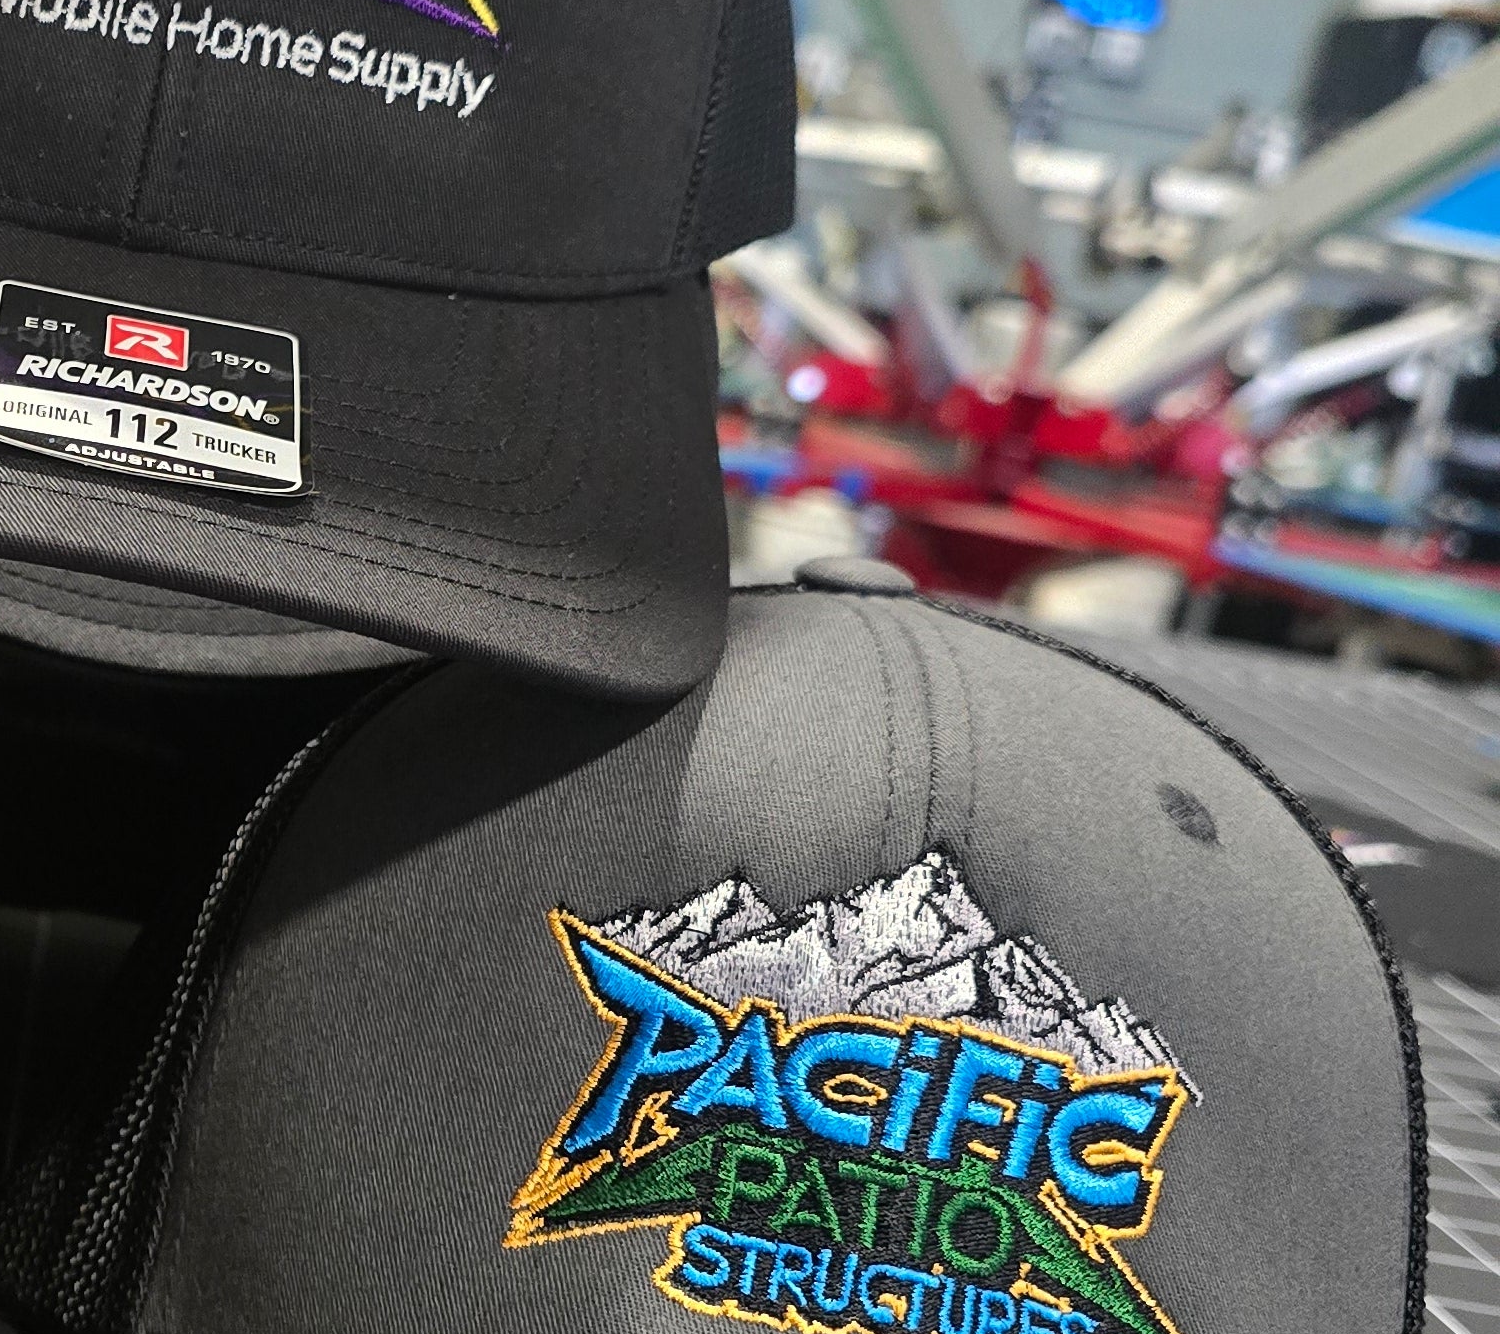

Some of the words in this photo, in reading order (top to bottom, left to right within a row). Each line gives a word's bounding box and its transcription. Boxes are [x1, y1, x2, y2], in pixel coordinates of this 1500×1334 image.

[165, 2, 325, 77] Home
[327, 30, 497, 118] Supply
[24, 316, 82, 336] EST.
[210, 349, 272, 375] 1970
[2, 398, 94, 427] ORIGINAL
[104, 407, 180, 451] 112
[190, 431, 278, 466] TRUCKER
[64, 442, 216, 481] ADJUSTABLE
[709, 1141, 1016, 1278] PATIO
